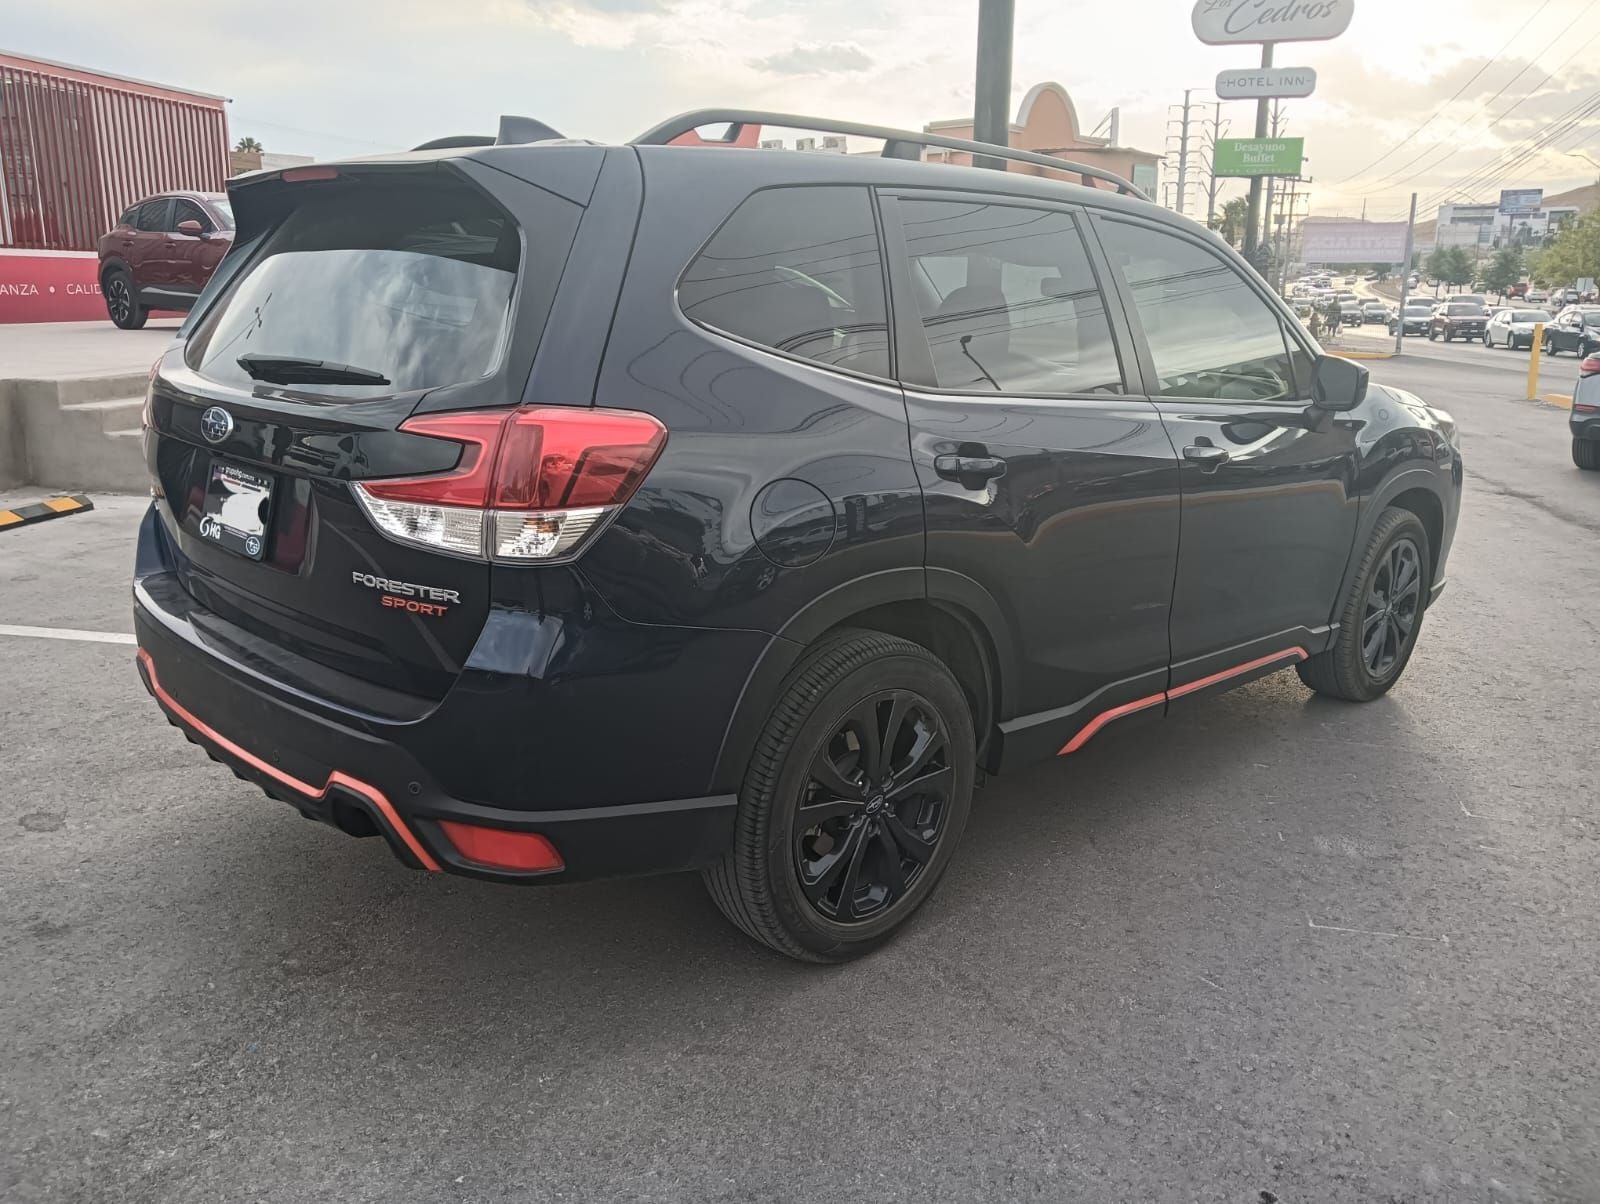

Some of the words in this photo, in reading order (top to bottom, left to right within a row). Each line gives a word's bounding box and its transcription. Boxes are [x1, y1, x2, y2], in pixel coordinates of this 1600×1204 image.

[1224, 0, 1337, 34] Cedros
[1226, 77, 1274, 88] HOTEL
[1279, 76, 1305, 87] INN
[1234, 142, 1286, 153] Desayuno
[1242, 151, 1275, 163] Buffet
[352, 571, 461, 604] FORESTER
[381, 594, 449, 617] SPORT
